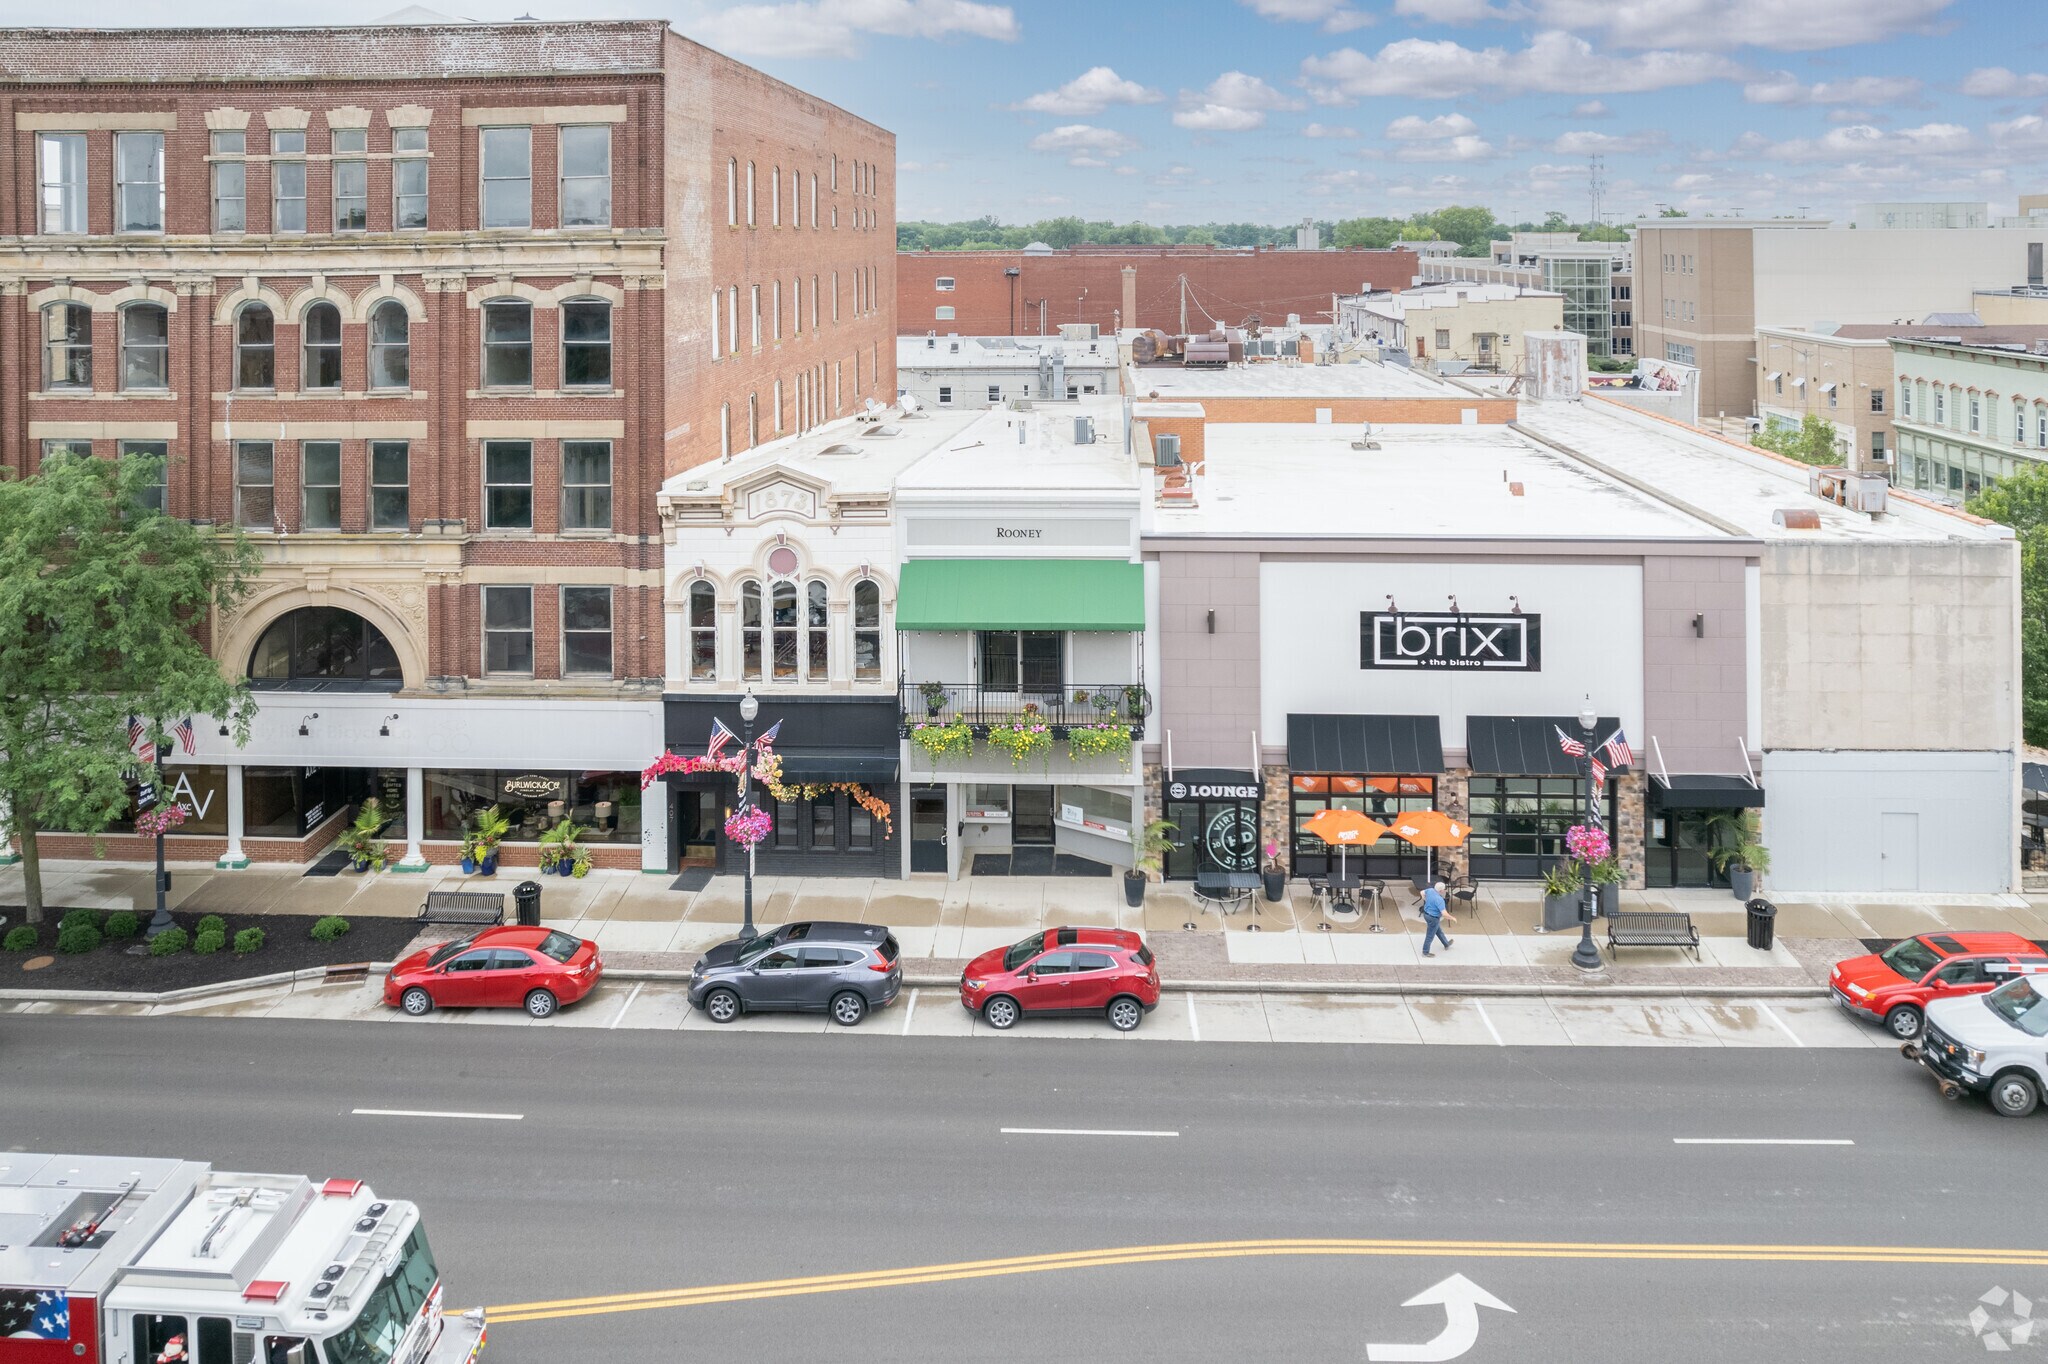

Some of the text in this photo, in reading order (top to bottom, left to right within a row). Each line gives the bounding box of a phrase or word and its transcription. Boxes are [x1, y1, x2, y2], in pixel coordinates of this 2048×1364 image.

[1396, 616, 1504, 657] brix
[1449, 659, 1481, 667] bistro
[1190, 785, 1259, 798] LOUNGE
